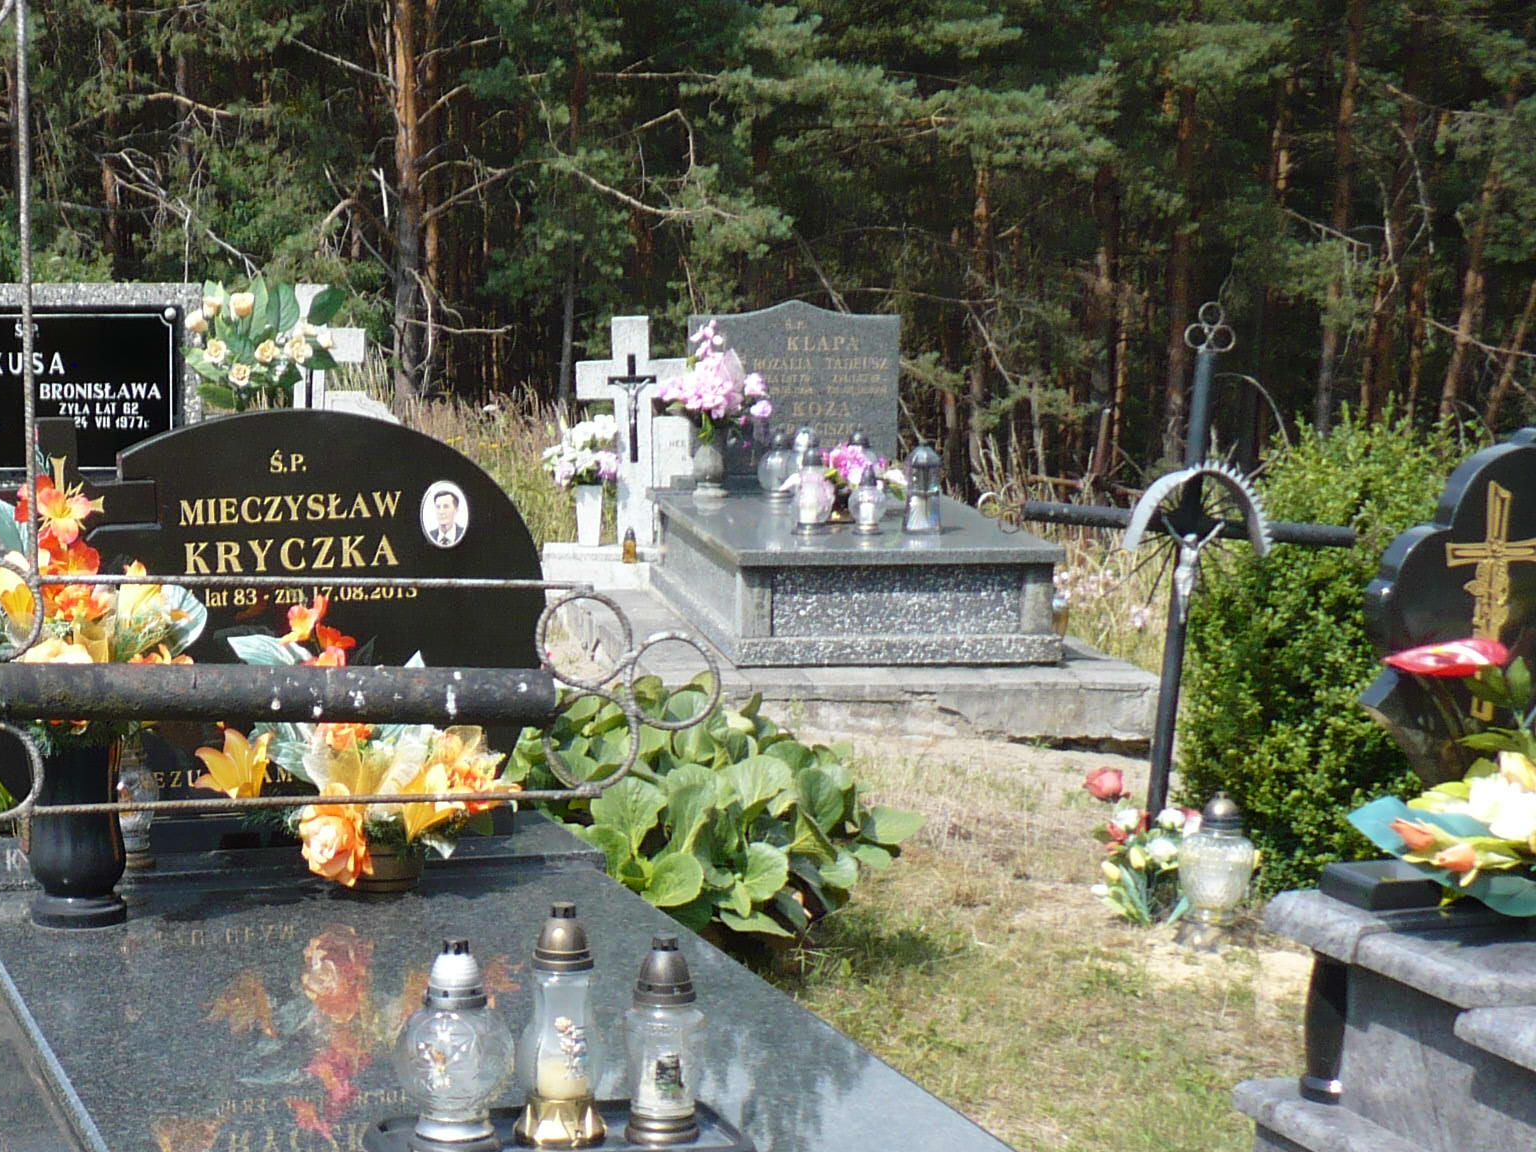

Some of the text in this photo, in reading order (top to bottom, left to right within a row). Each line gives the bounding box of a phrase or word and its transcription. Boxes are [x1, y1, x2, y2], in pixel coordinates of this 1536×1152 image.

[39, 382, 161, 400] BRONISŁAWA
[95, 402, 116, 414] LAT
[122, 402, 139, 414] 62
[95, 417, 111, 429] VII
[270, 449, 307, 474] Ś.P.
[179, 490, 402, 526] MIECZYSŁAW
[184, 535, 400, 575] KRYCZKA
[205, 588, 229, 608] lat
[233, 587, 257, 606] 83
